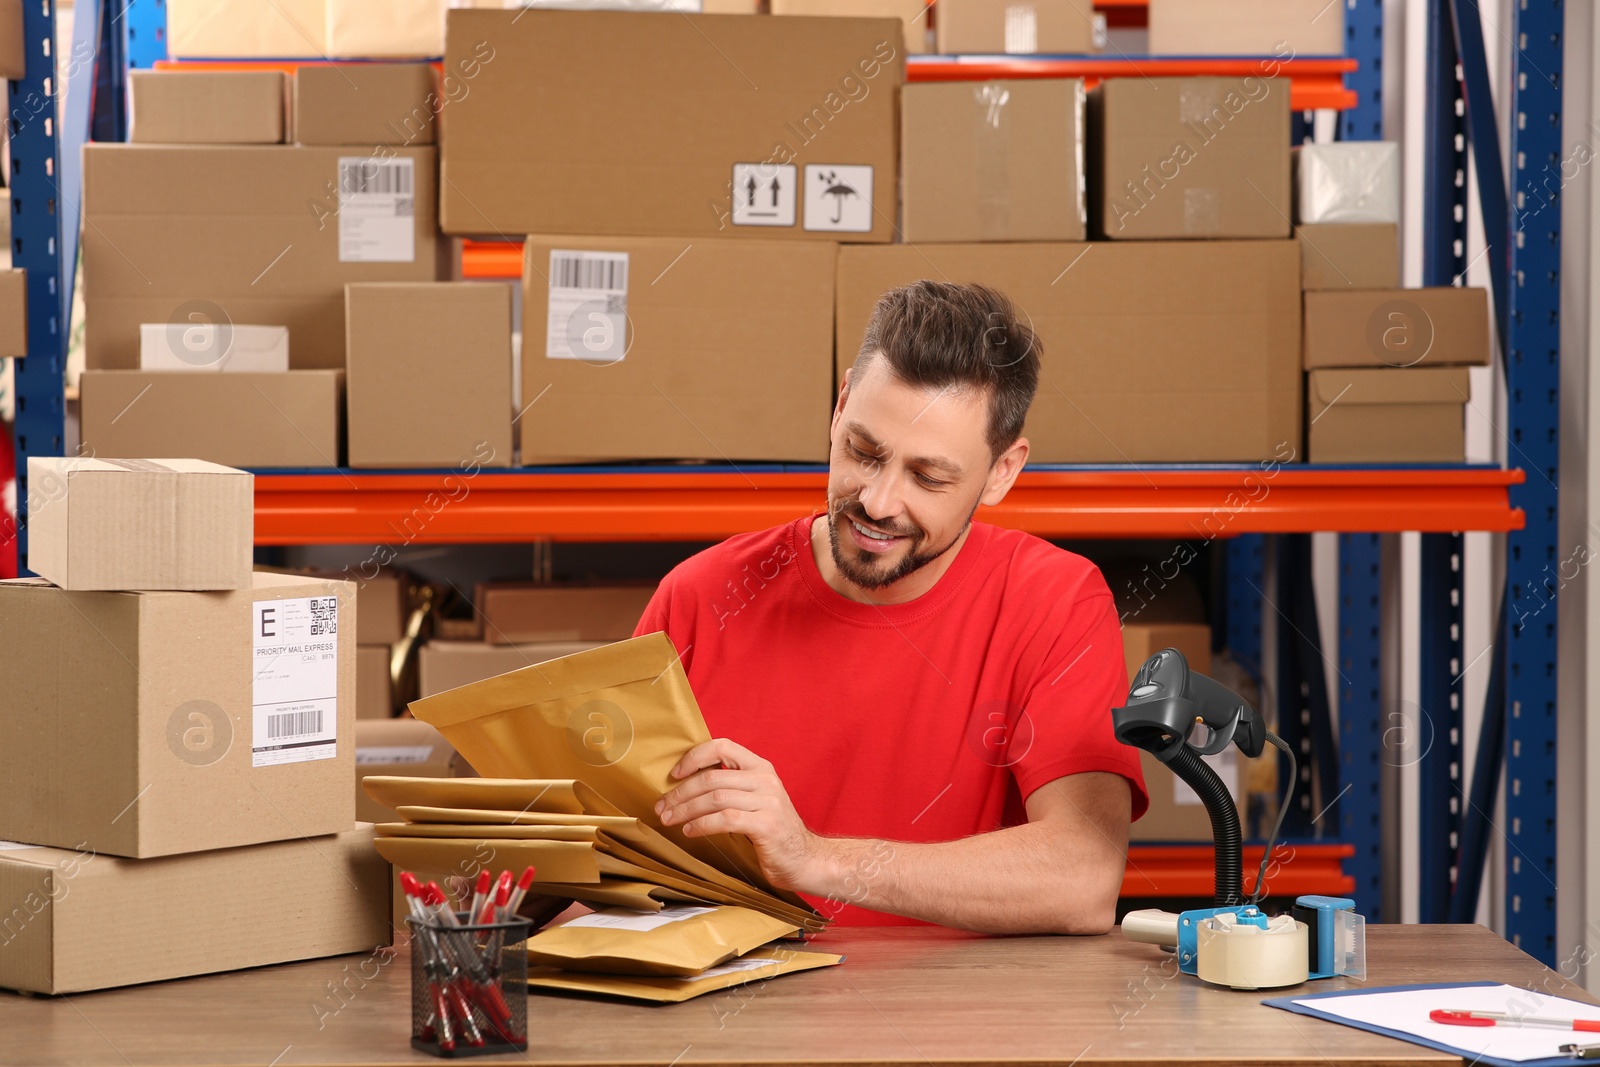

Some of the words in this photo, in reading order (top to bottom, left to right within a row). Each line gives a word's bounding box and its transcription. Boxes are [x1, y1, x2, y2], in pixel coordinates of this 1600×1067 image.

[261, 608, 275, 637] E
[256, 646, 287, 656] PRIORITY
[288, 645, 303, 653] MAIL
[304, 642, 334, 652] EXPRESS
